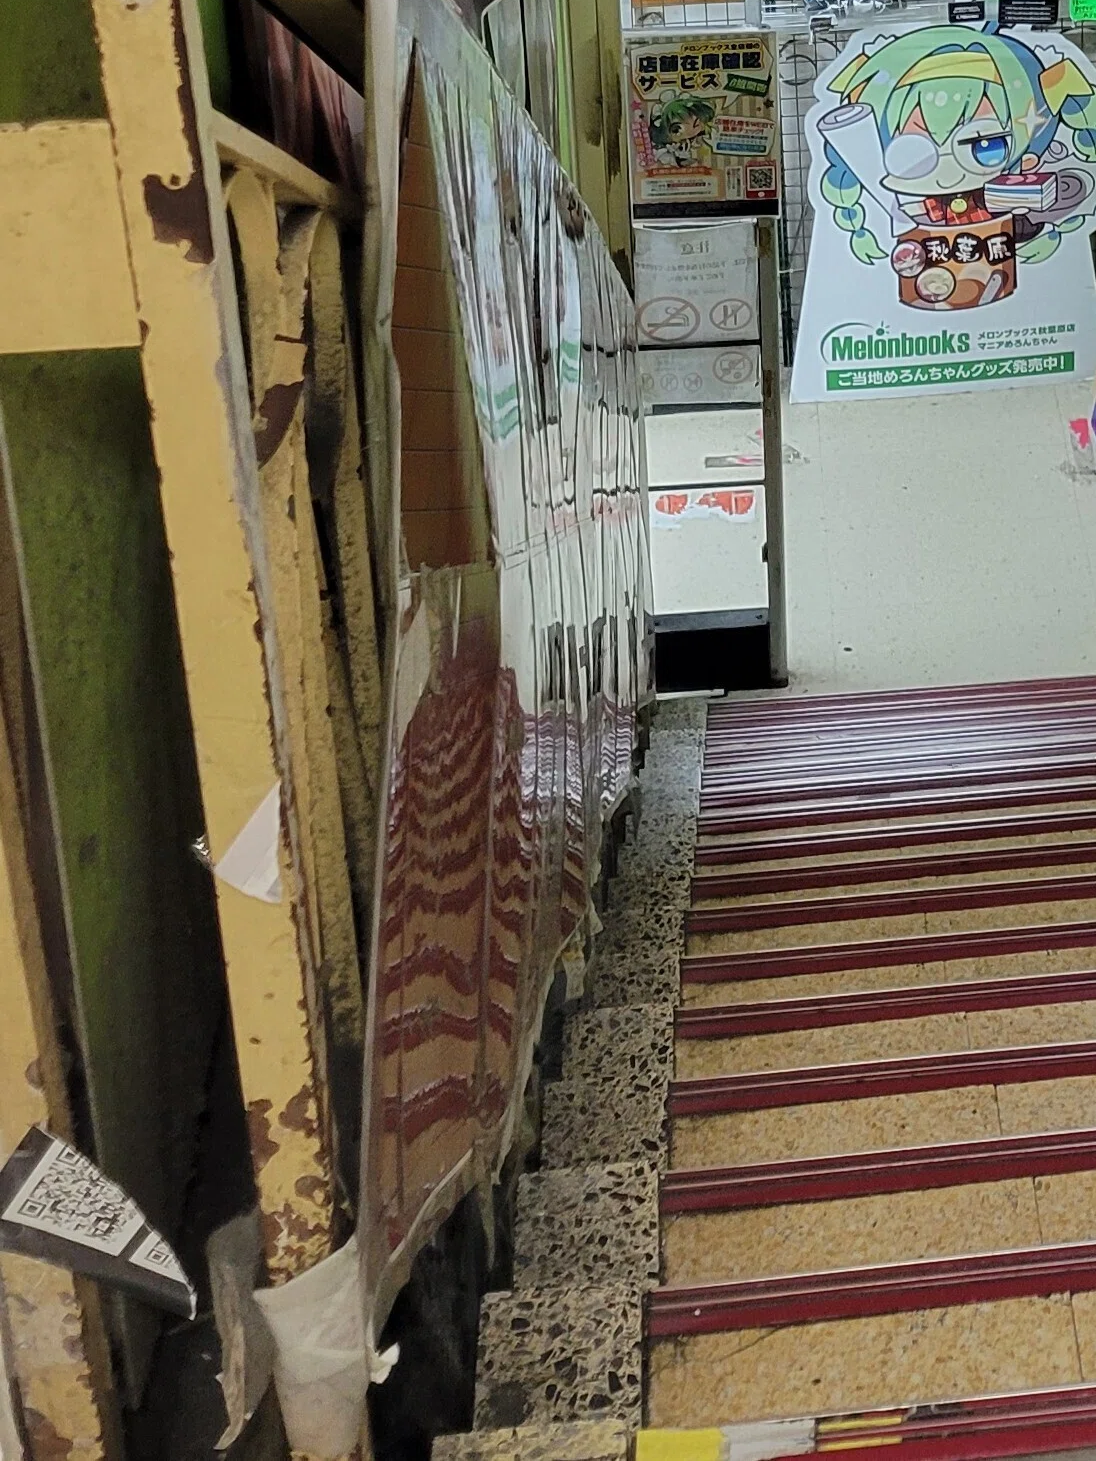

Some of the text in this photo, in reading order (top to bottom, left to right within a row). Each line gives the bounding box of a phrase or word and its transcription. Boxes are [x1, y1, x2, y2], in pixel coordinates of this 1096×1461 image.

[638, 73, 719, 92] サービス
[925, 236, 1011, 262] 秋葉原
[977, 323, 1076, 341] メロンブックス秋葉原店
[831, 329, 971, 362] Melonbooks
[977, 336, 1058, 351] マニアめろんちゃん
[838, 359, 1066, 387] ご当地めろんちゃんグッズ発売中！
